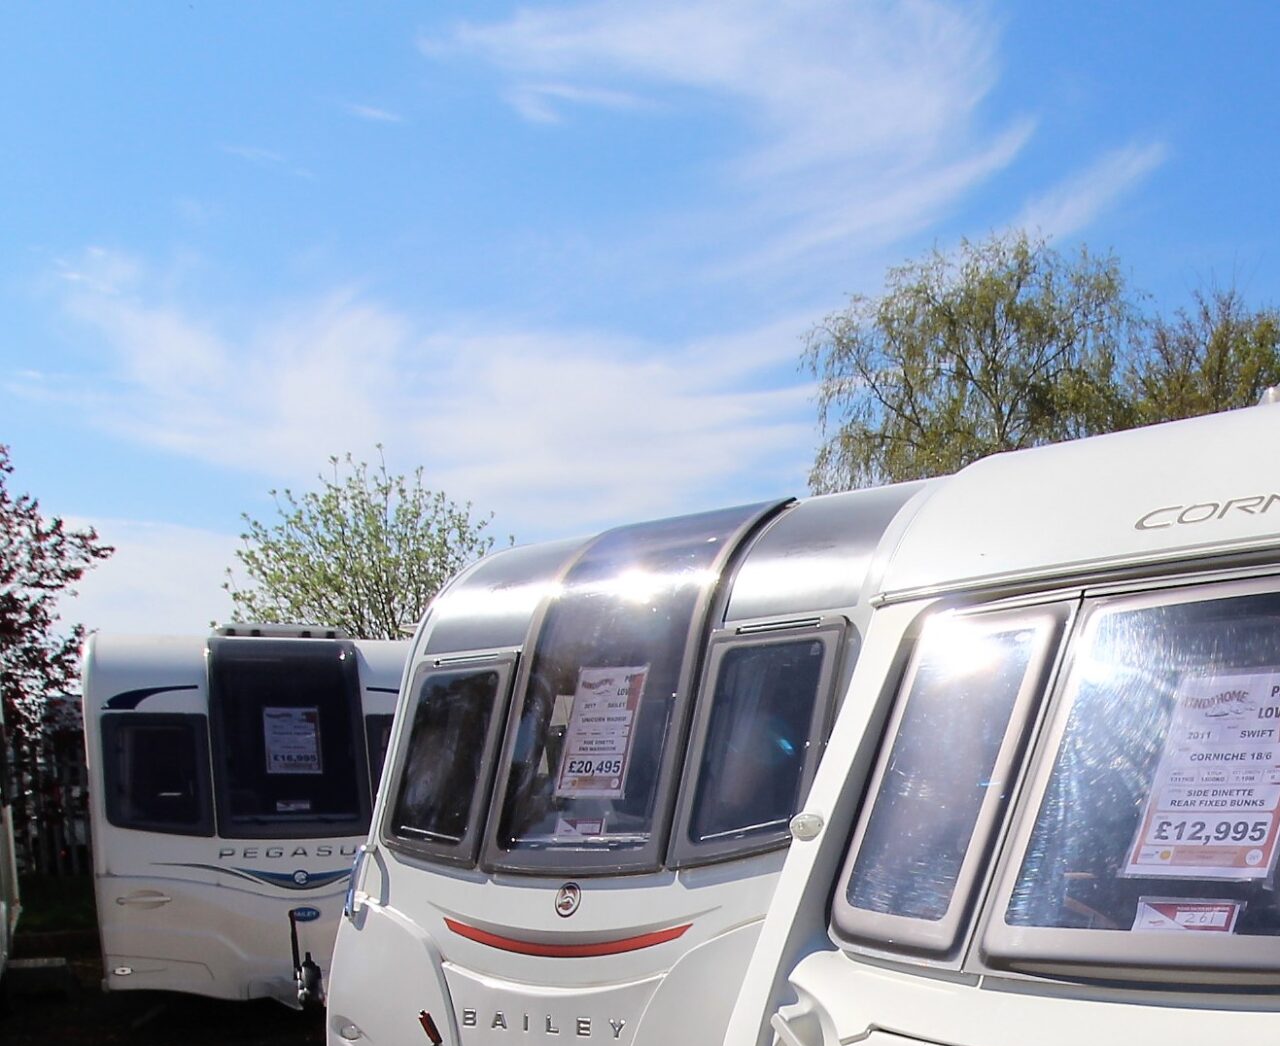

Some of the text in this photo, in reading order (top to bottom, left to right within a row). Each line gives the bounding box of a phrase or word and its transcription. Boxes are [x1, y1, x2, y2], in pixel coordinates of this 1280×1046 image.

[1240, 729, 1275, 739] SWIFT
[1190, 752, 1247, 761] CORNICHE
[568, 760, 621, 776] £20,495
[1187, 789, 1209, 797] SIDE
[1211, 788, 1255, 797] DINETTE
[1170, 799, 1265, 807] REAR FIXED BUNKS
[1153, 821, 1269, 846] £12,995
[218, 845, 357, 860] PEGASU
[462, 1007, 627, 1040] BAILEY
